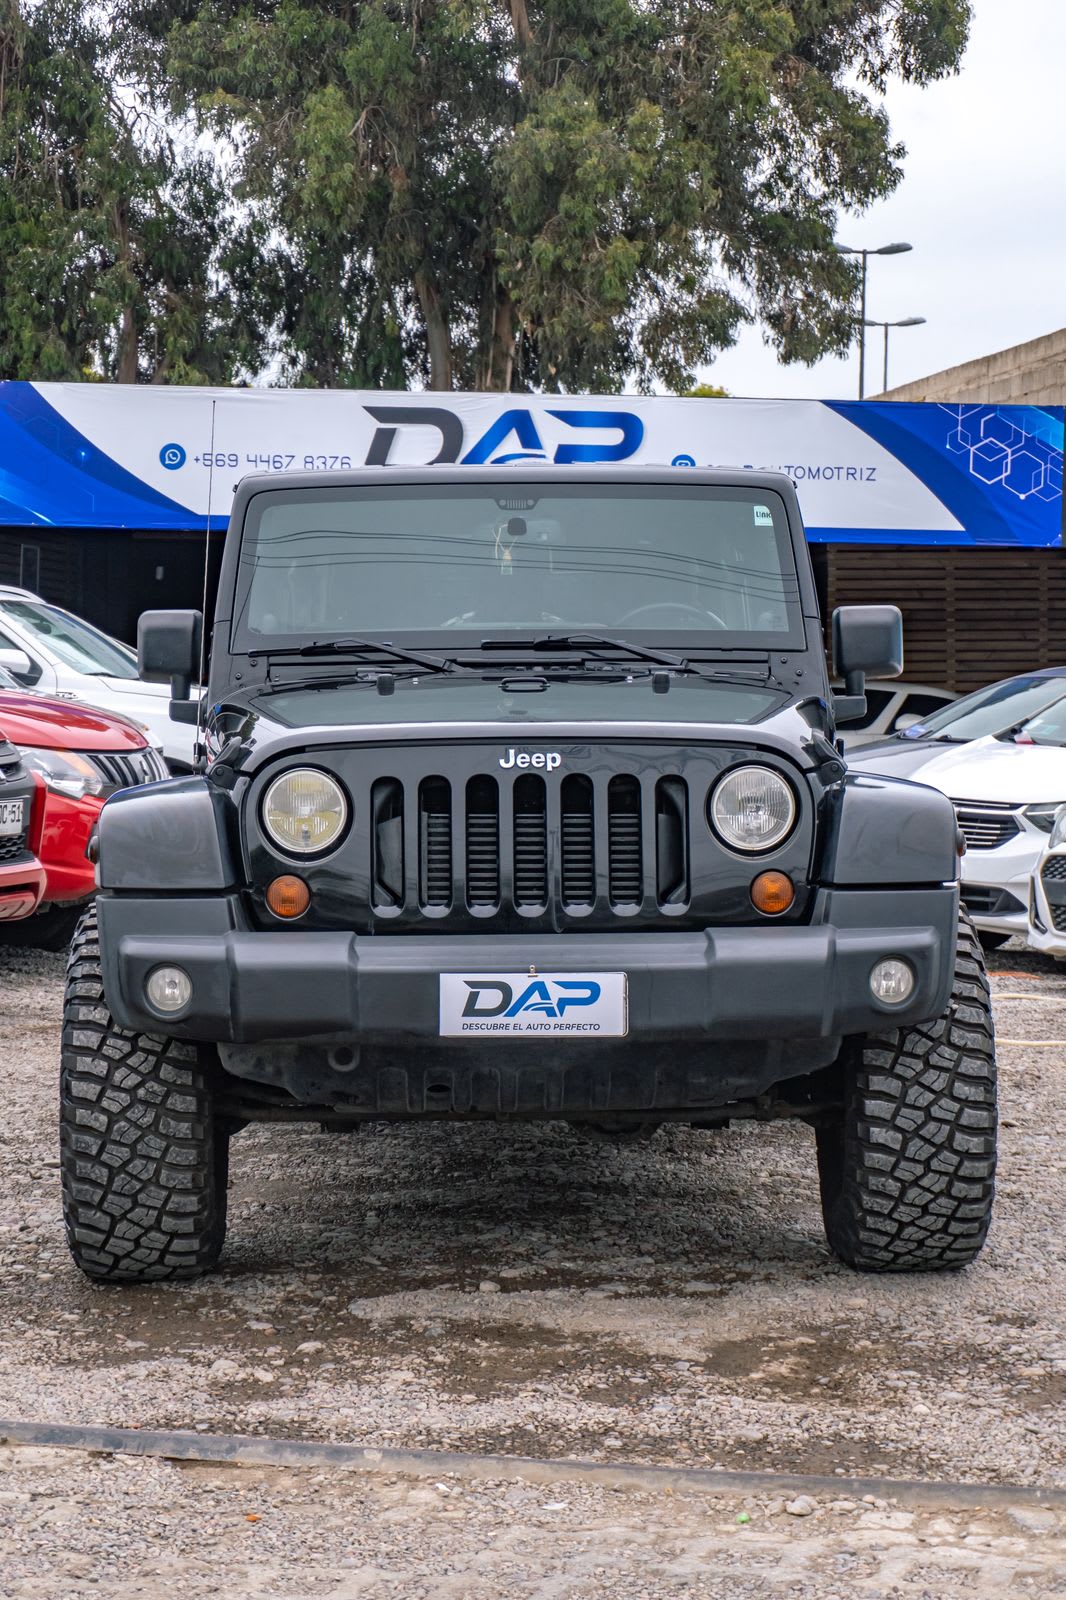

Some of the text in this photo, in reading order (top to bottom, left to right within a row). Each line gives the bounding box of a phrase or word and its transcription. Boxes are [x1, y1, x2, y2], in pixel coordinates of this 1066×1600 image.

[361, 405, 645, 466] DAP
[194, 453, 239, 468] +569
[247, 454, 296, 470] 4467
[499, 748, 562, 771] Jeep
[461, 980, 601, 1018] DAP
[461, 1023, 601, 1031] DESCUBRE EL AUTO PERFECTO
